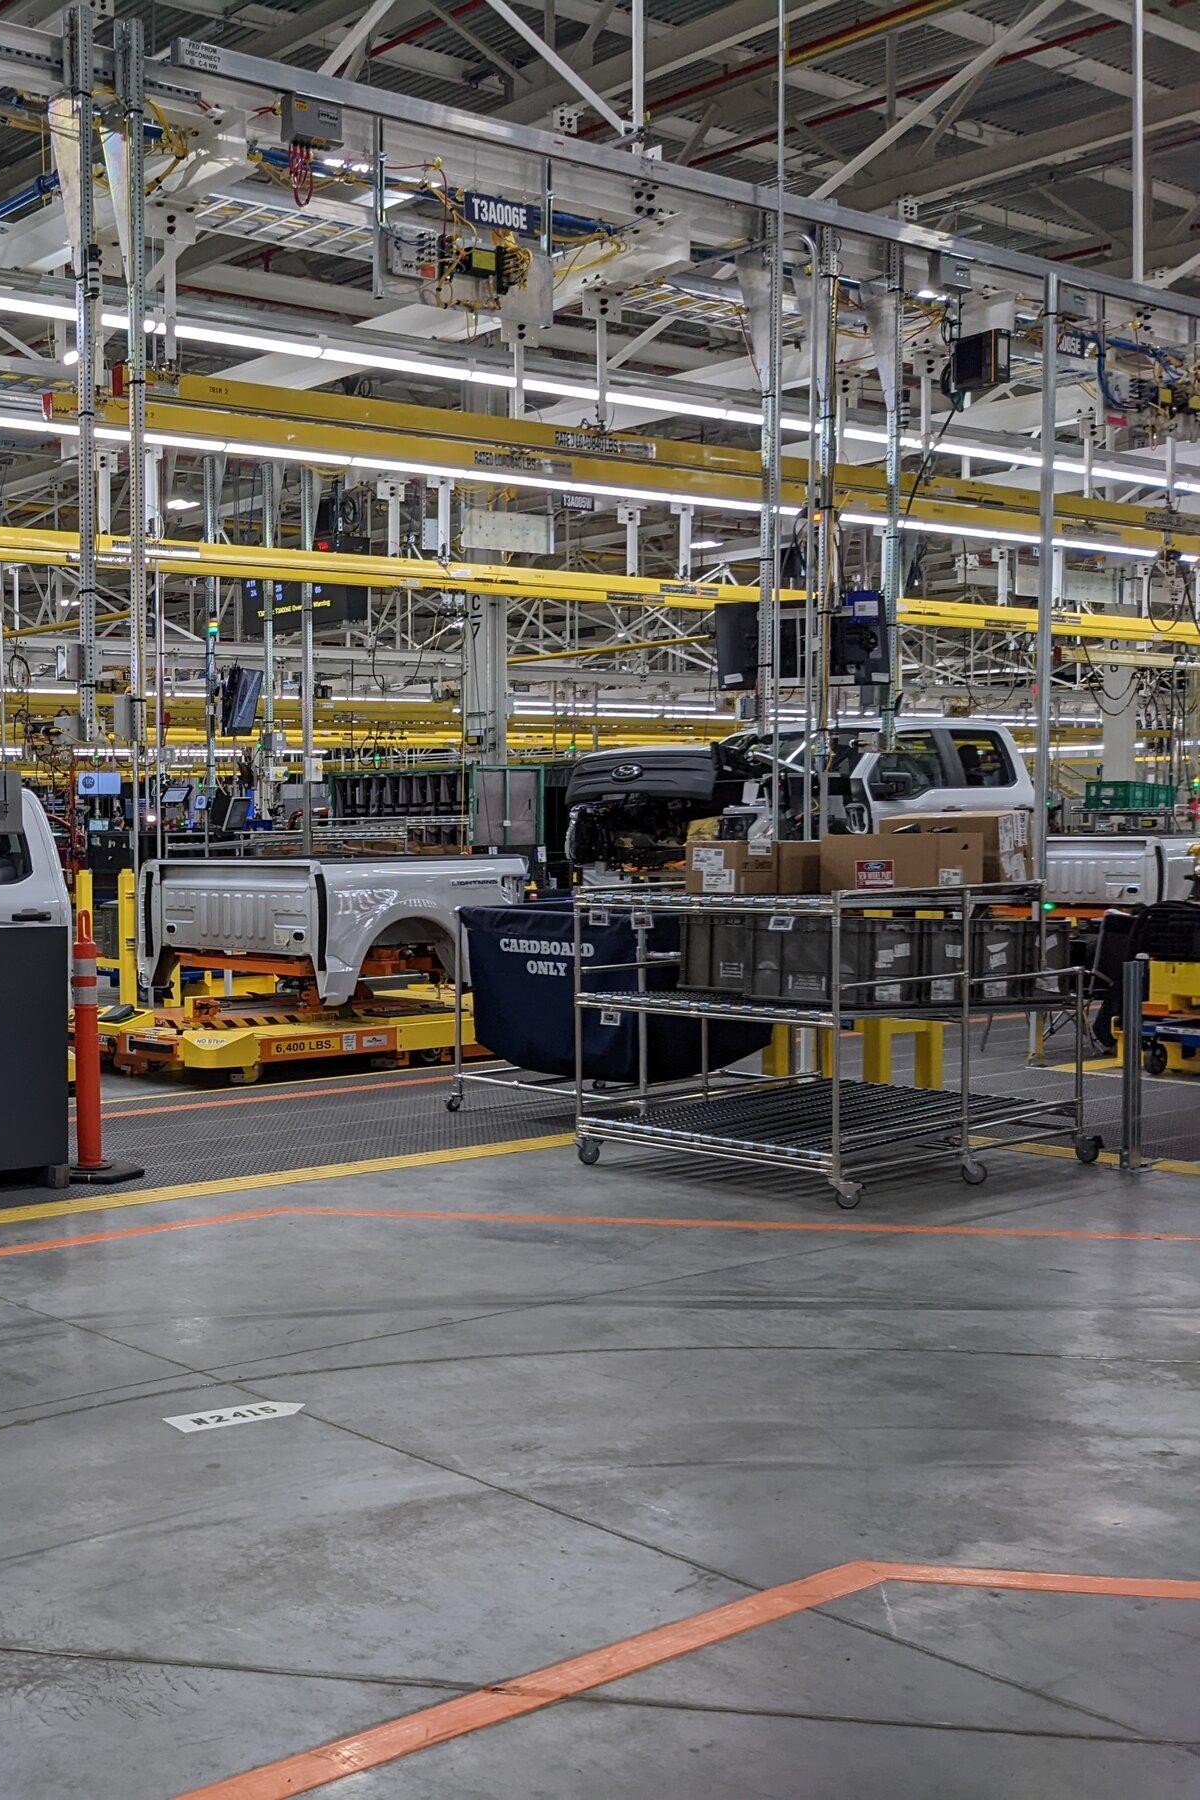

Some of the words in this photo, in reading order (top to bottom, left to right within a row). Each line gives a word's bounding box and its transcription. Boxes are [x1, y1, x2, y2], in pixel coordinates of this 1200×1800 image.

[185, 49, 221, 63] DISCONNECT
[472, 198, 528, 230] T3A006E
[555, 430, 574, 447] RATED
[451, 879, 498, 887] LIGHTNING
[500, 938, 595, 957] CARDBOARD
[526, 960, 568, 977] ONLY
[275, 1042, 305, 1054] 6,400
[309, 1040, 335, 1051] LBS.
[189, 1405, 278, 1426] N2415
